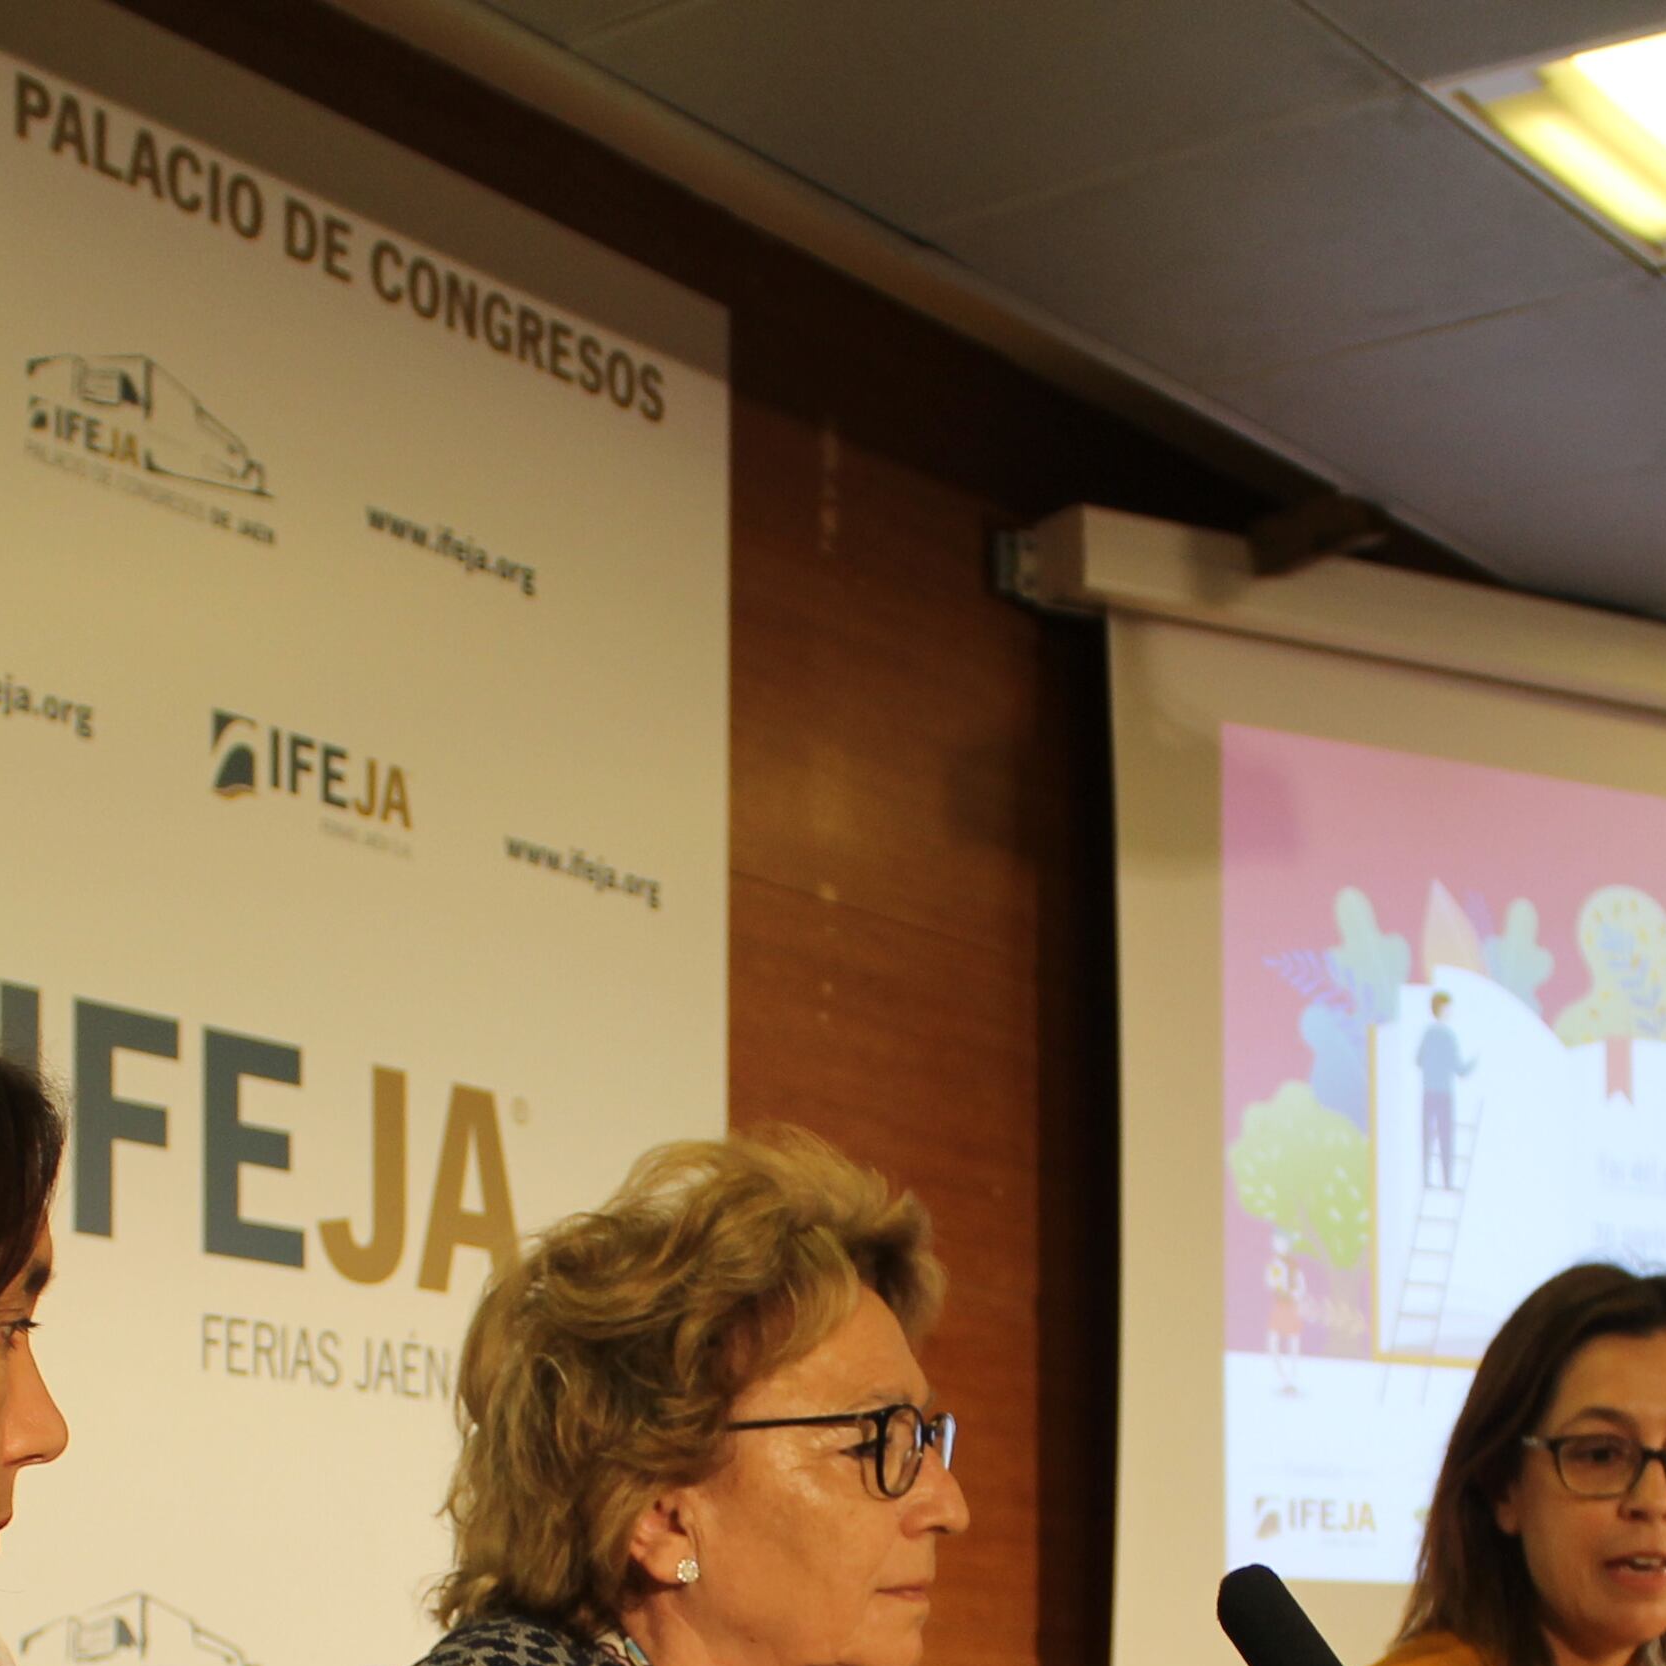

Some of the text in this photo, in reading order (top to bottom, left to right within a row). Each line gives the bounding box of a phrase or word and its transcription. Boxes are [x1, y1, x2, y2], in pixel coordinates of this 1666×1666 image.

[14, 71, 667, 424] PALACIO DE CONGRESOS
[54, 405, 139, 468] IFEJA
[365, 504, 535, 597] www.ifeja.org
[268, 727, 413, 831] IFEJA
[504, 835, 663, 910] www.ifeja.org
[201, 1312, 450, 1399] FERIAS JAÉN
[1288, 1497, 1379, 1534] IFEJA
